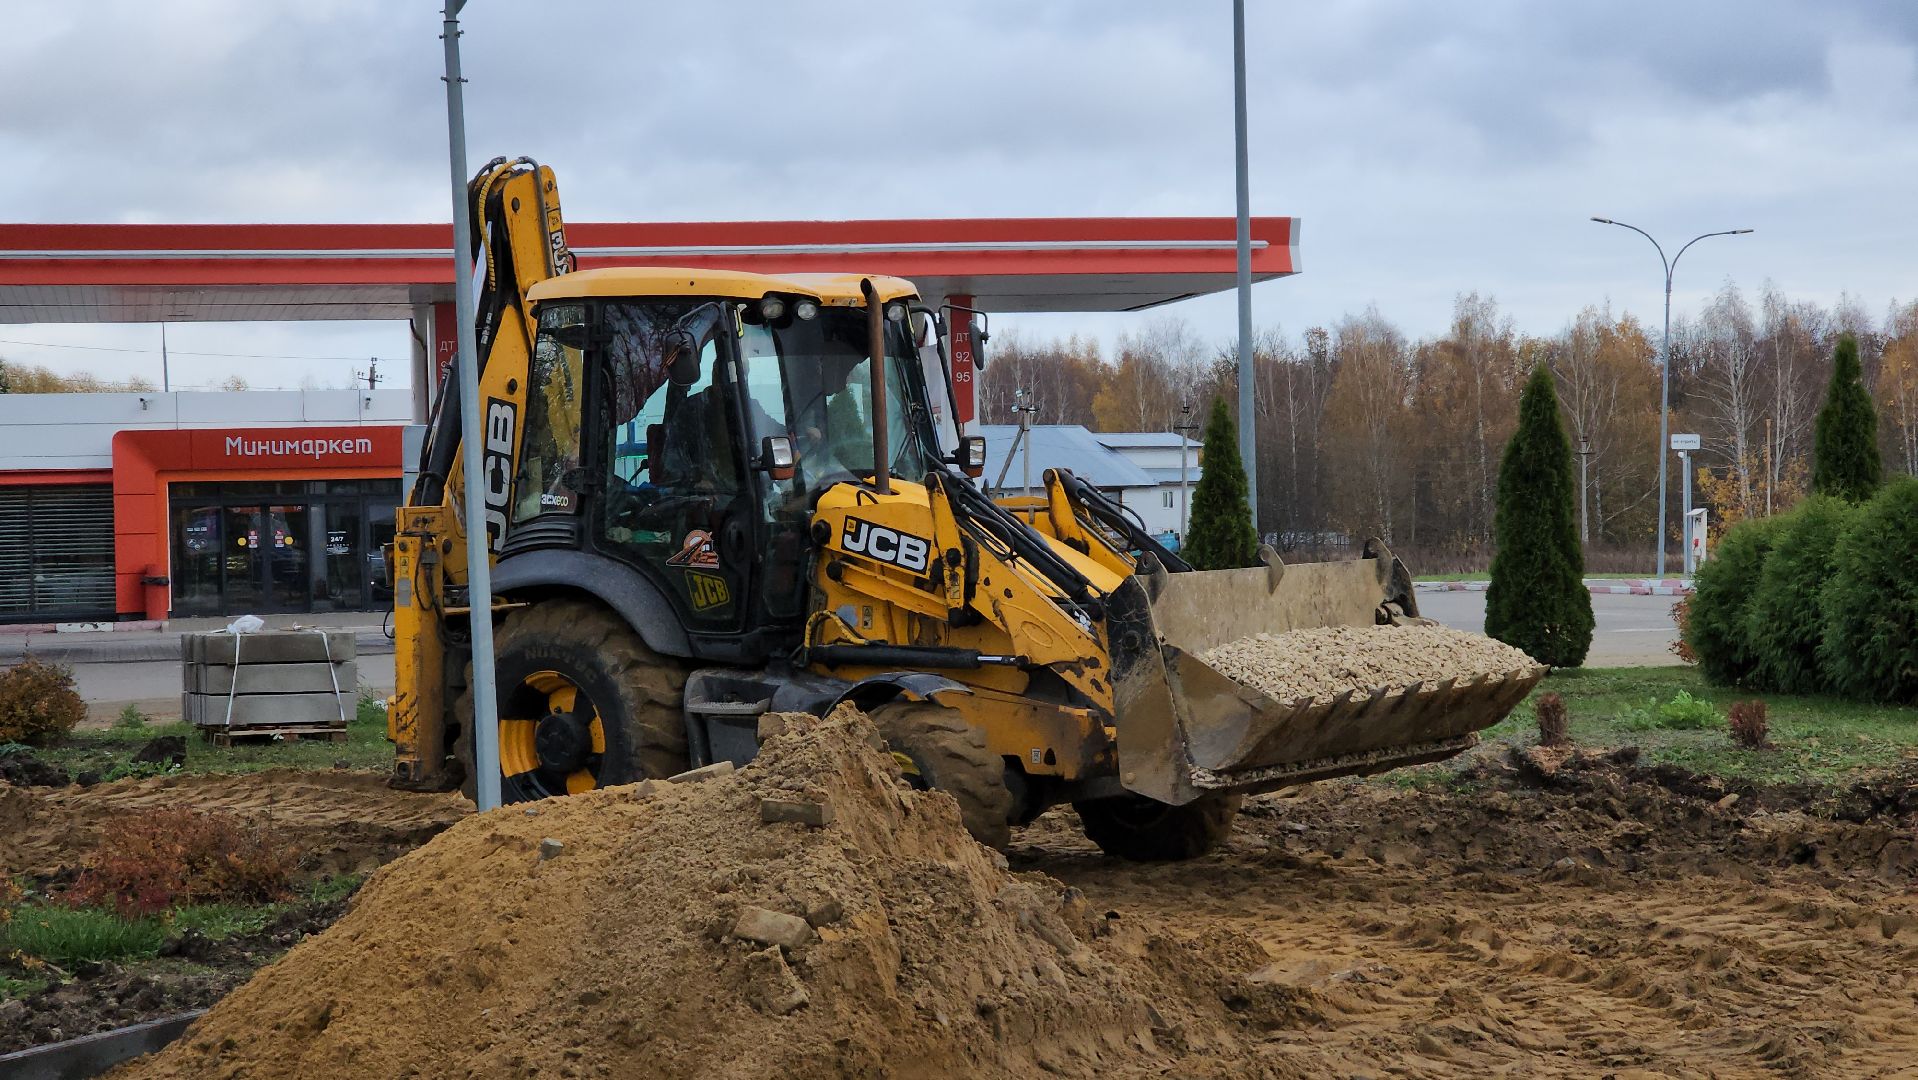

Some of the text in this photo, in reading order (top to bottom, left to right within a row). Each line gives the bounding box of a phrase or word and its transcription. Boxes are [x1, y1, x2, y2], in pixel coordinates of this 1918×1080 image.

[440, 341, 455, 352] ДТ
[955, 333, 969, 343] ДТ
[955, 351, 970, 362] 92
[956, 371, 970, 382] 95
[225, 436, 372, 460] Минимаркет
[484, 403, 514, 551] JCB
[843, 522, 927, 571] JCB
[693, 574, 727, 607] JCB
